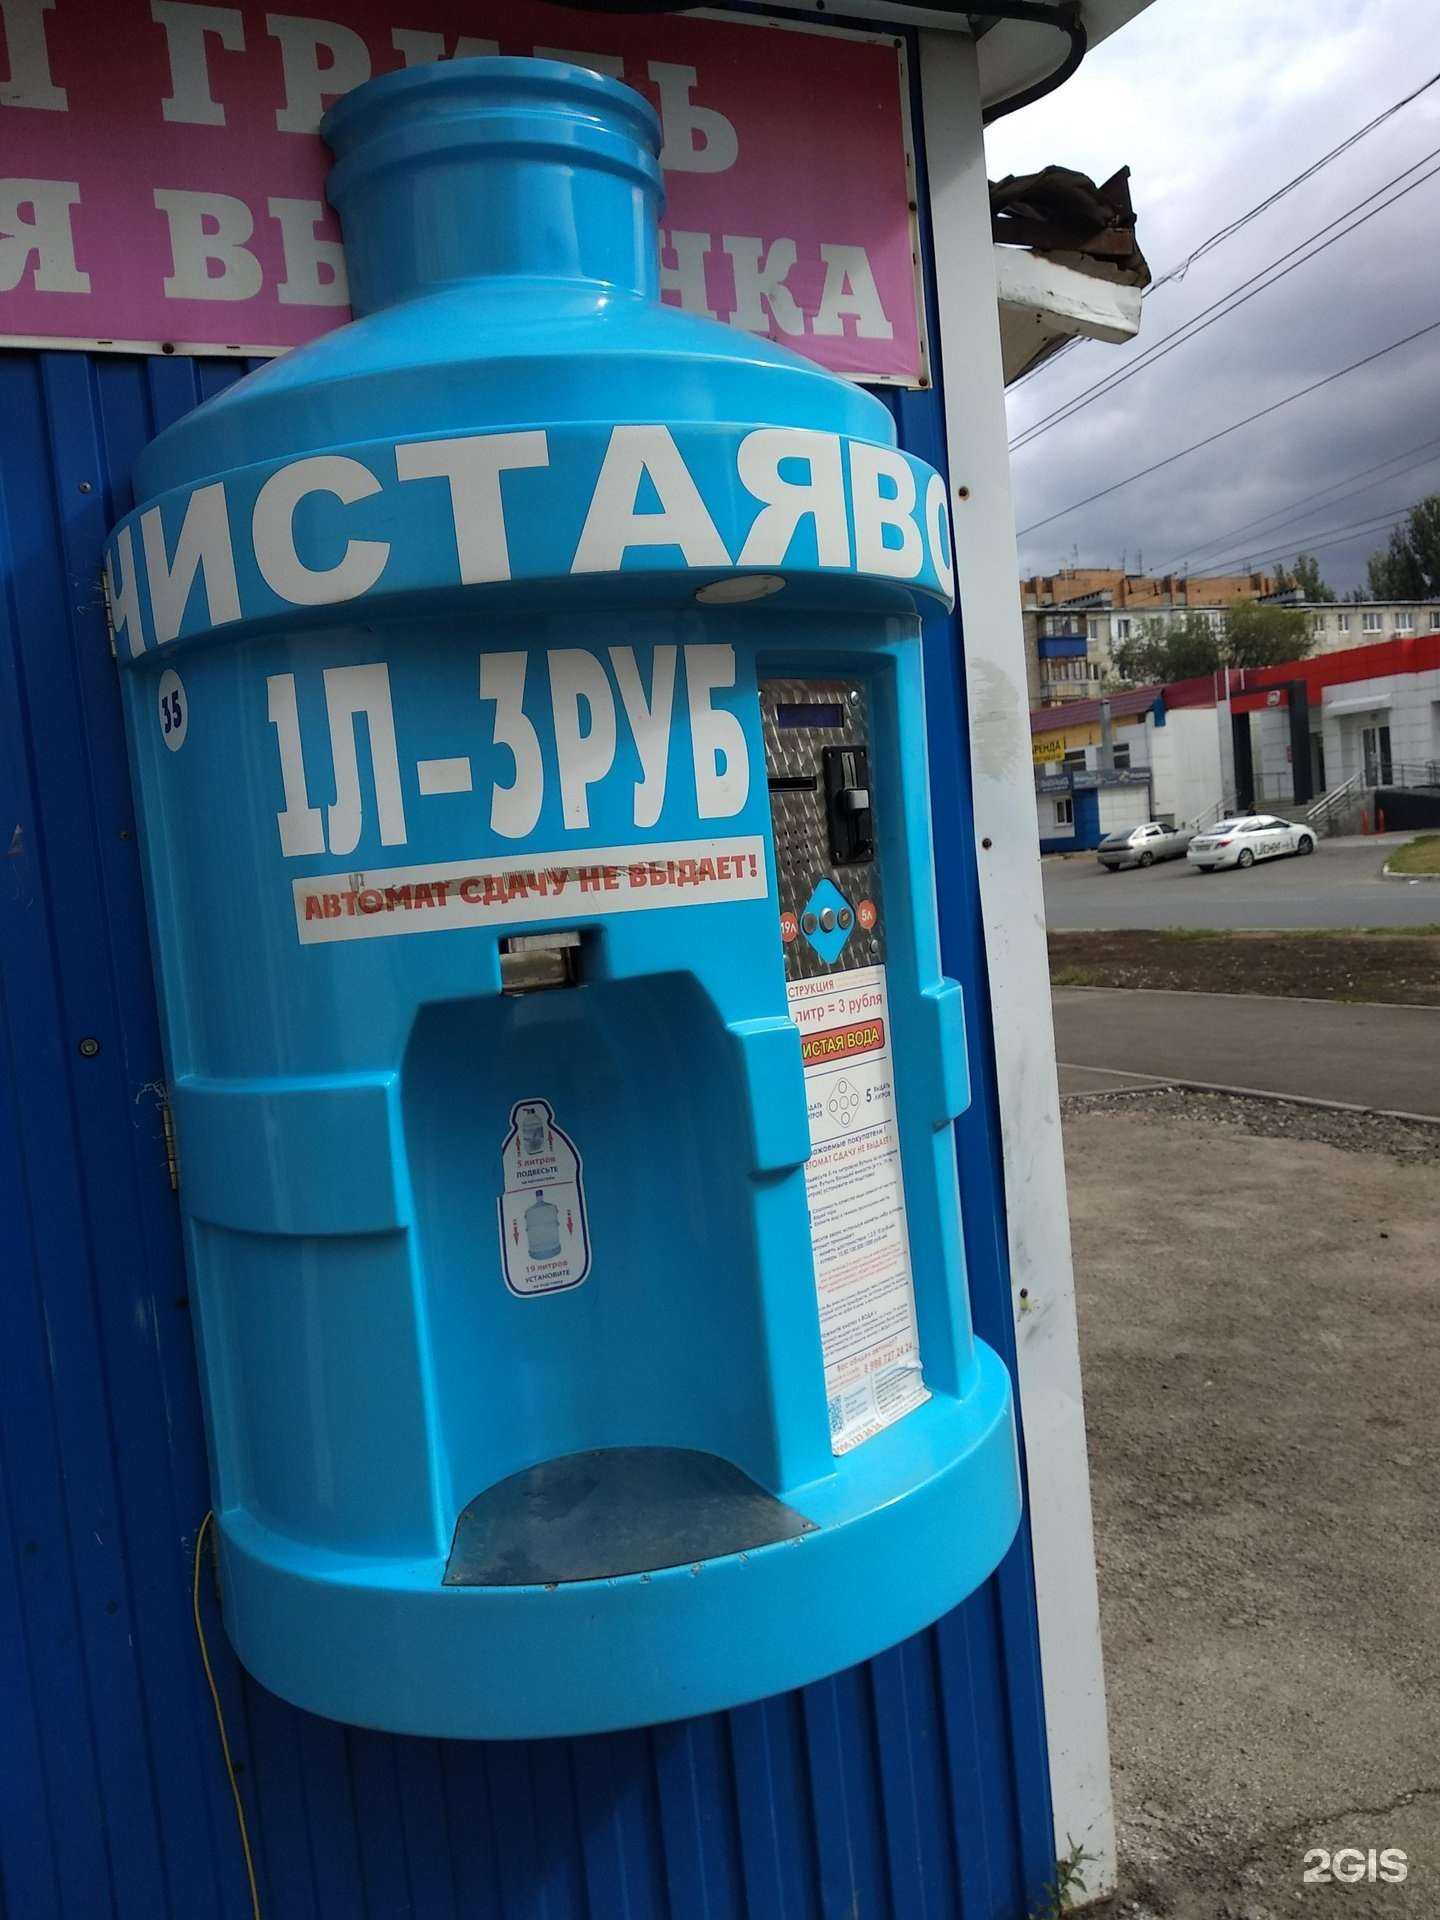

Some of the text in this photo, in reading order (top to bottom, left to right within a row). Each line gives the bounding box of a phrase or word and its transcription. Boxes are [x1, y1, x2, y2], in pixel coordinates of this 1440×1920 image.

[154, 3, 739, 173] ГРЬ
[161, 690, 182, 734] 35
[1033, 739, 1061, 753] РЕНДА
[305, 854, 758, 920] АВТОМАТ СДАЧУ НЕ ВЫДАЕТ!
[839, 998, 846, 1013] 3
[849, 992, 883, 1014] рубля
[847, 1026, 880, 1048] ВОДА
[866, 1088, 872, 1103] 5
[517, 1167, 558, 1178] ПОДВЕСЬТЕ
[525, 1270, 570, 1283] УСТАНОВИТЕ
[526, 1264, 535, 1273] 19
